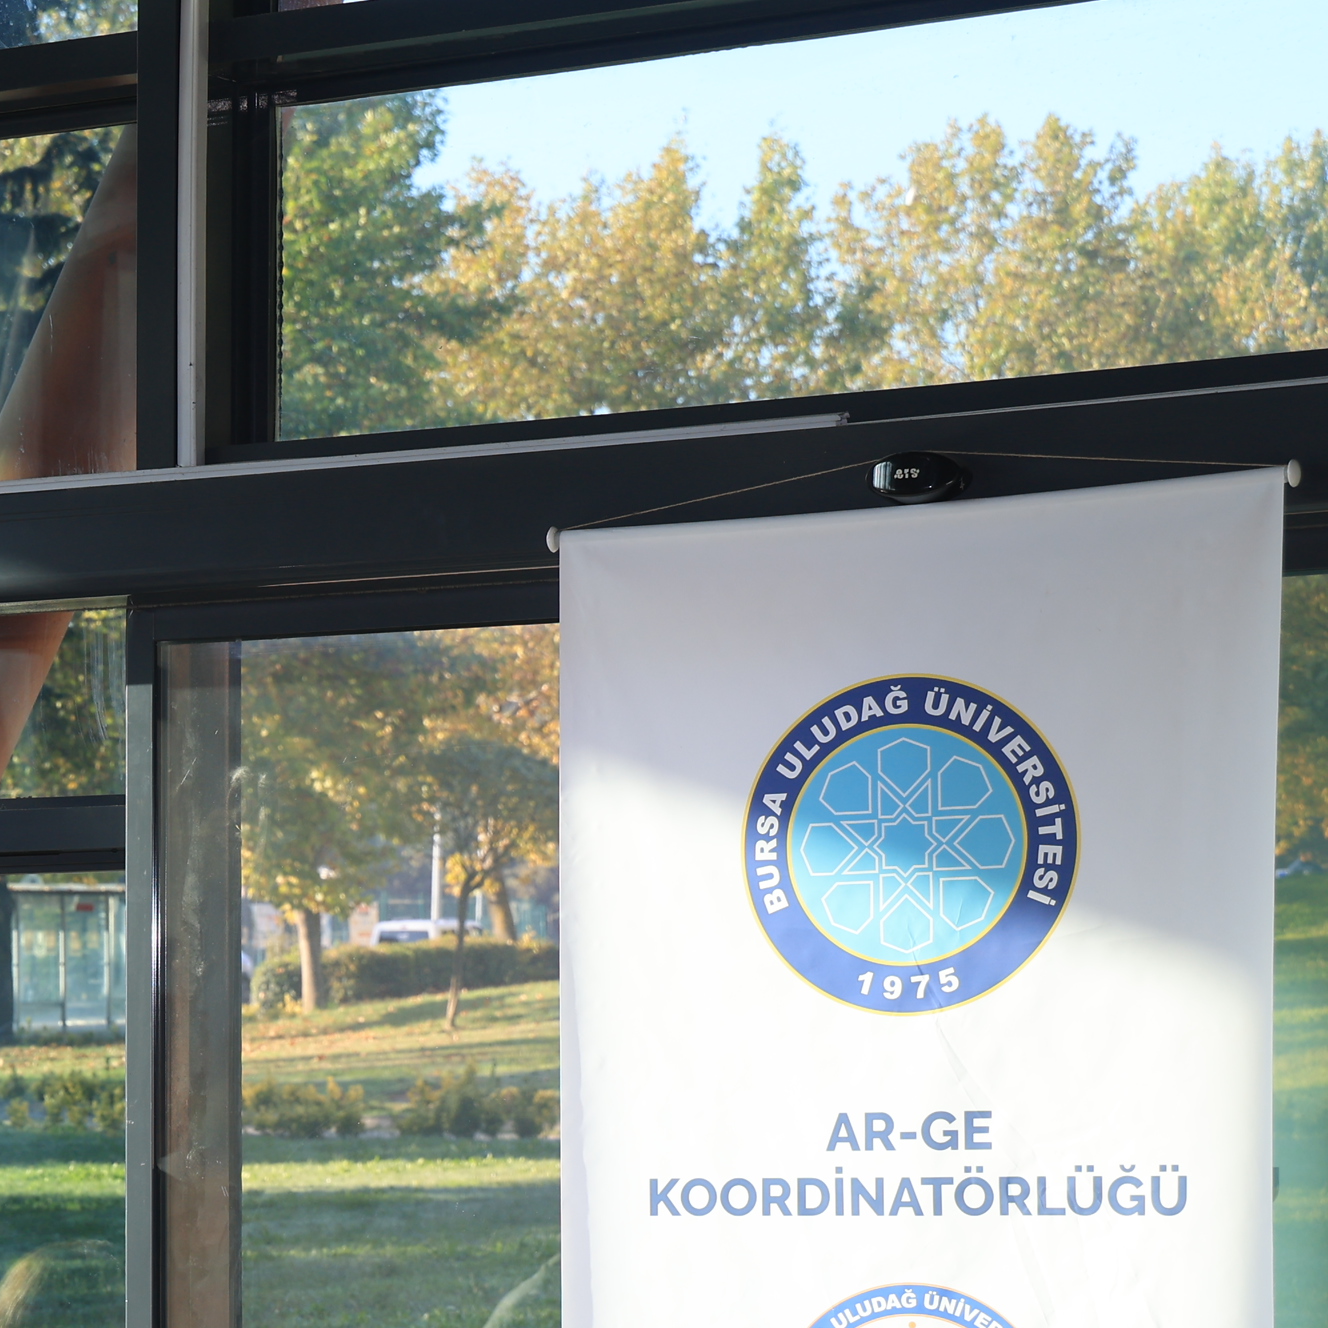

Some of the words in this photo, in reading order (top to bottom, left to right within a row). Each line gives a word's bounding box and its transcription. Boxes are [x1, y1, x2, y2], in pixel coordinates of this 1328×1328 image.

[755, 791, 789, 915] BURSA
[777, 685, 908, 781] ULUDAĞ
[924, 686, 1065, 907] ÜNİVERSİTESİ
[857, 967, 961, 1000] 1975
[825, 1110, 993, 1152] AR-GE
[648, 1163, 1188, 1217] KOORDİNATÖRLÜĞÜ
